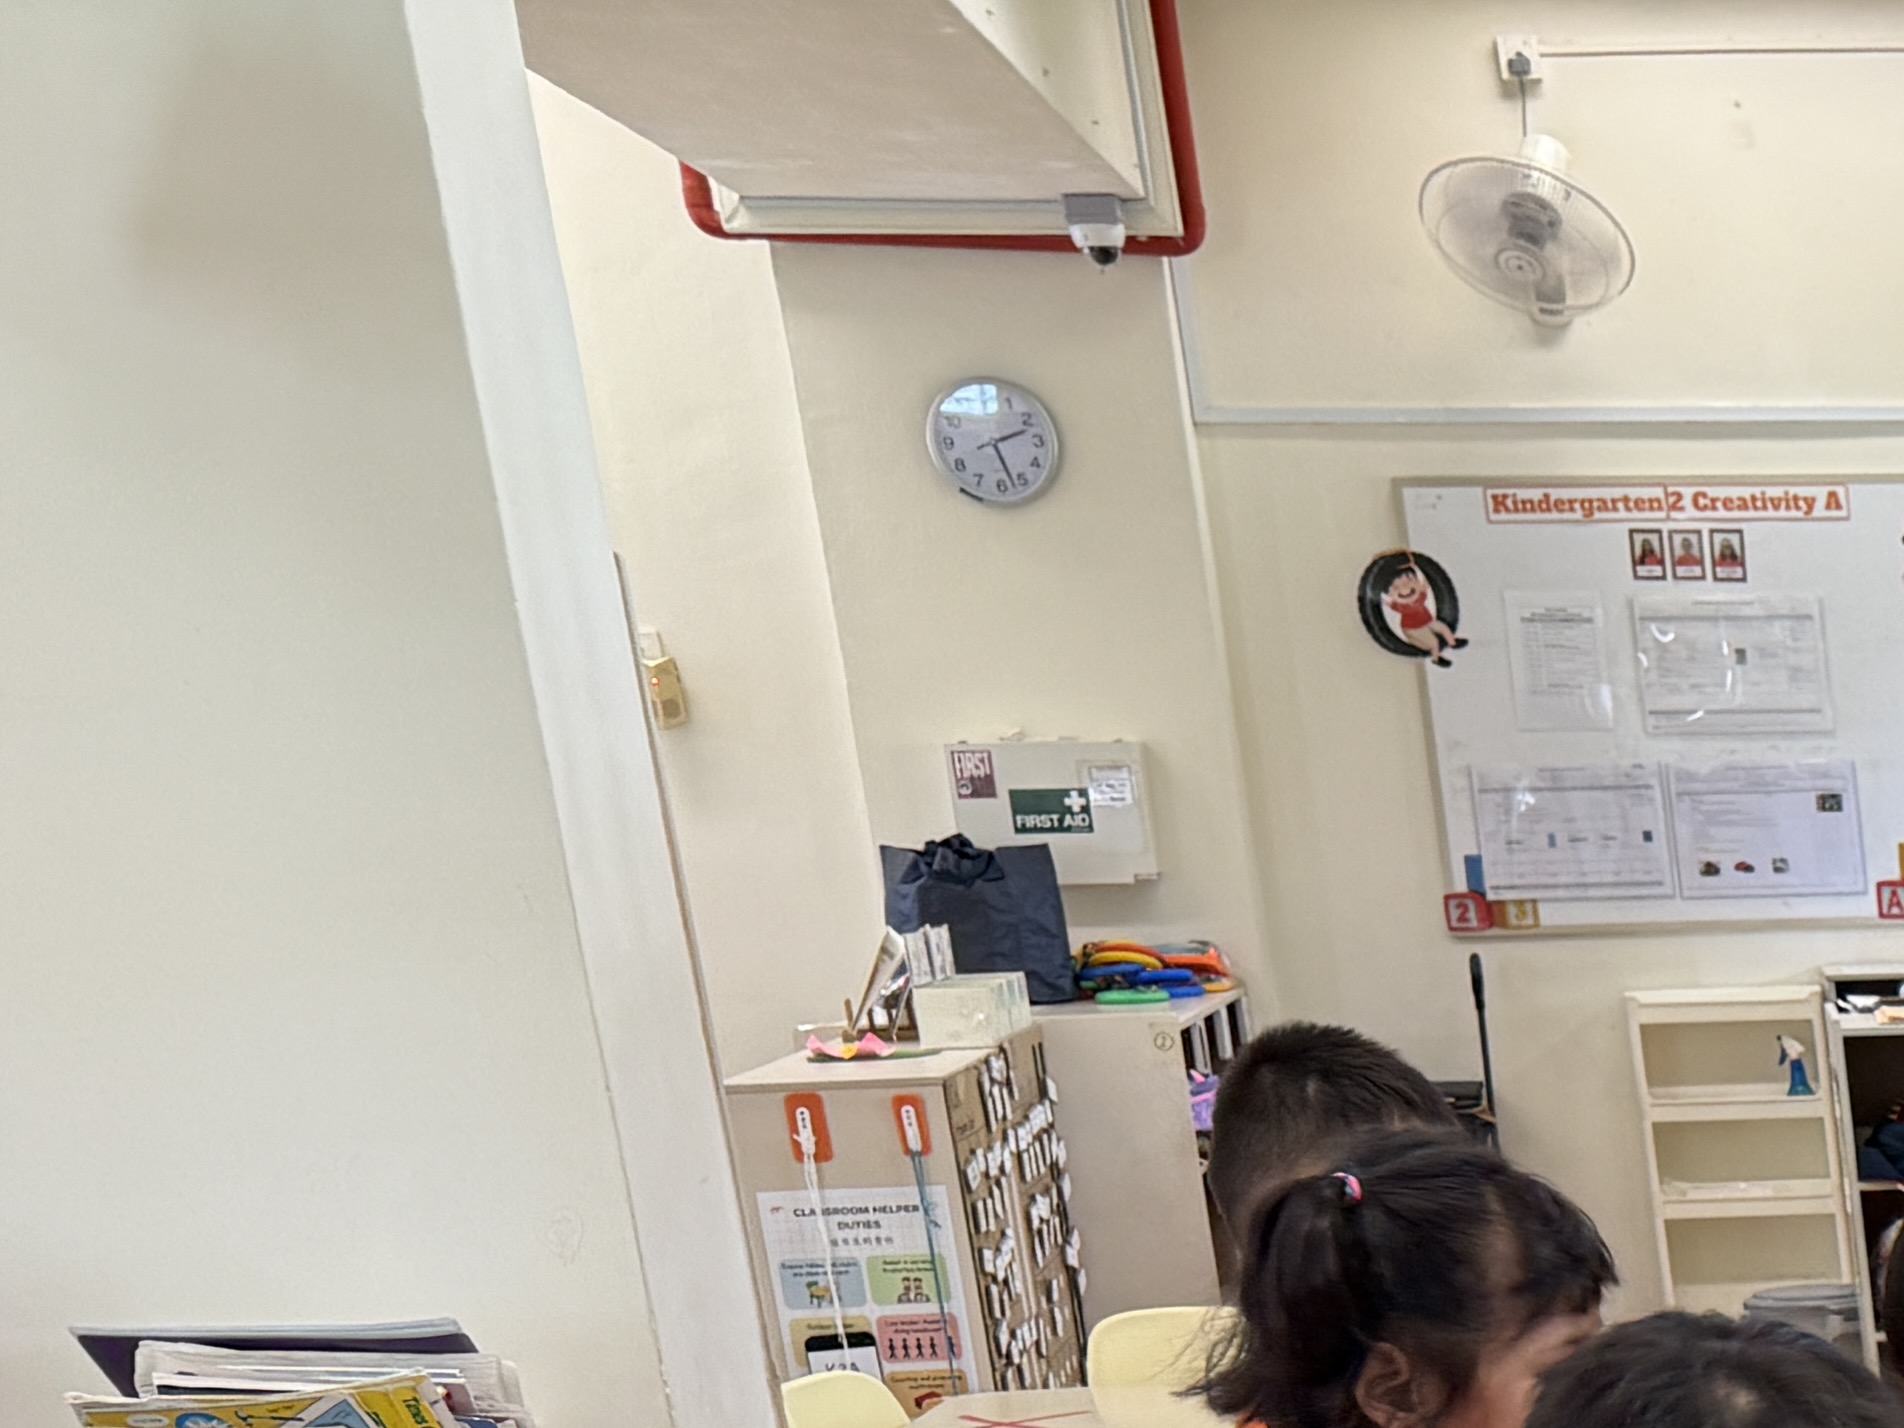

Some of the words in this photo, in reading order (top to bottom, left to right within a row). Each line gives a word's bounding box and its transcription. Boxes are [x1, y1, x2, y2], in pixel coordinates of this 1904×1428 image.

[1022, 412, 1034, 426] 2
[943, 436, 954, 450] 9
[1032, 434, 1044, 448] 3
[954, 458, 966, 472] 8
[1030, 456, 1041, 468] 4
[973, 473, 984, 487] 7
[996, 479, 1008, 493] 6
[1017, 472, 1028, 486] 5
[1492, 493, 1665, 520] Kindergarten
[1668, 491, 1686, 513] 2
[1693, 490, 1816, 515] Creativity
[1824, 490, 1843, 511] A
[1016, 814, 1059, 828] FIRST
[1063, 814, 1089, 827] AID
[1887, 889, 1904, 914] A
[1455, 902, 1470, 924] 2
[837, 1220, 882, 1230] DUTIES
